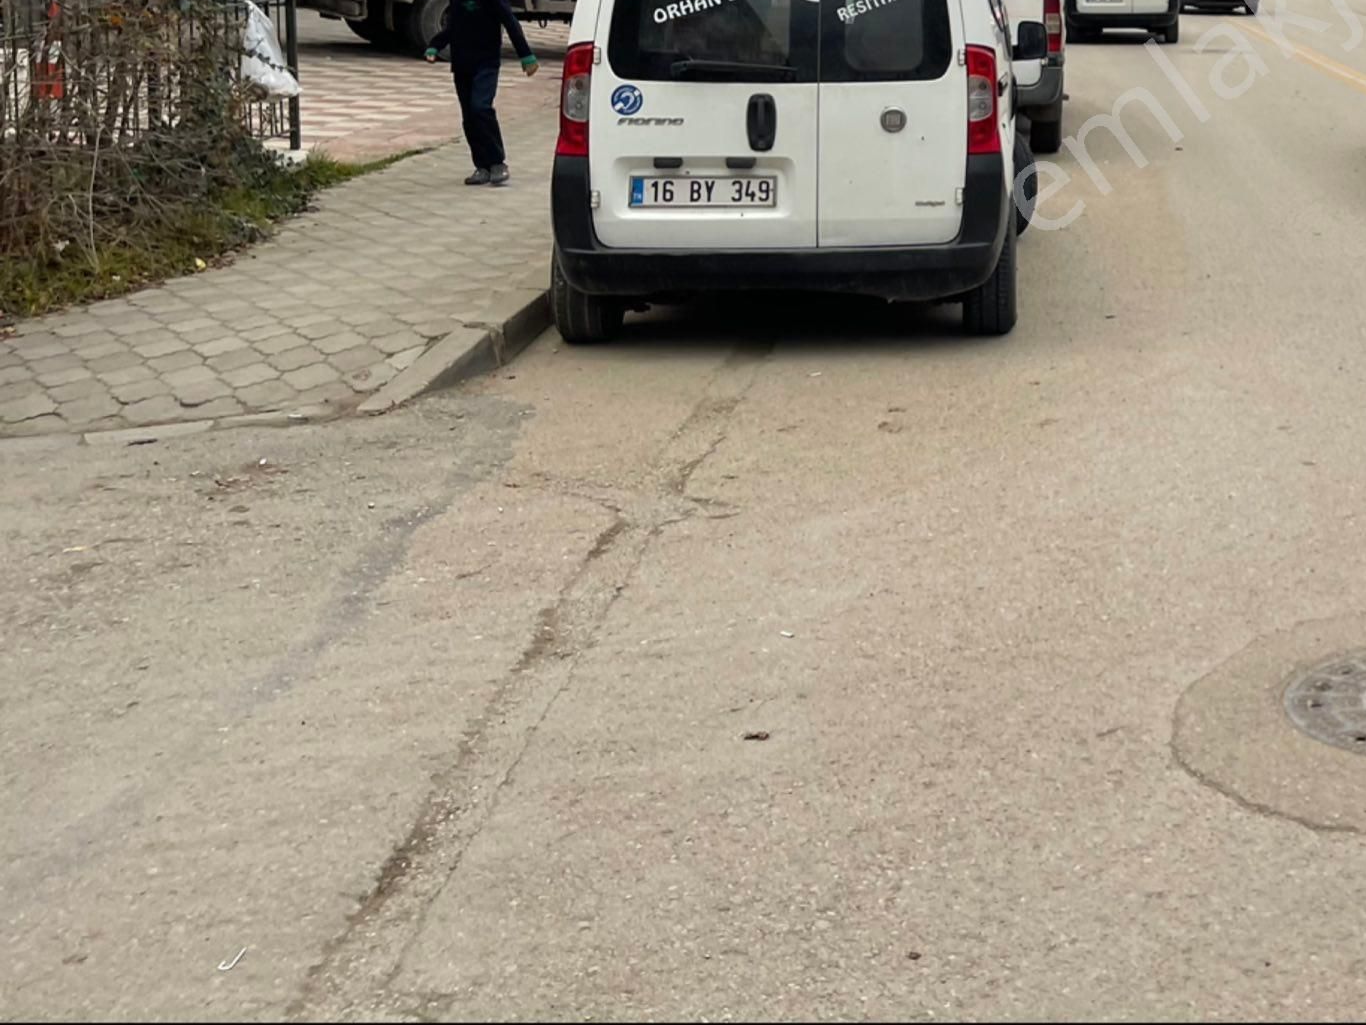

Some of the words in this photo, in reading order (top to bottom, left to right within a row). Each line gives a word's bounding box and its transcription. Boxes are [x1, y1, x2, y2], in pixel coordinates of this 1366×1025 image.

[651, 180, 674, 203] 16
[689, 180, 716, 203] BY
[731, 180, 770, 203] 349
